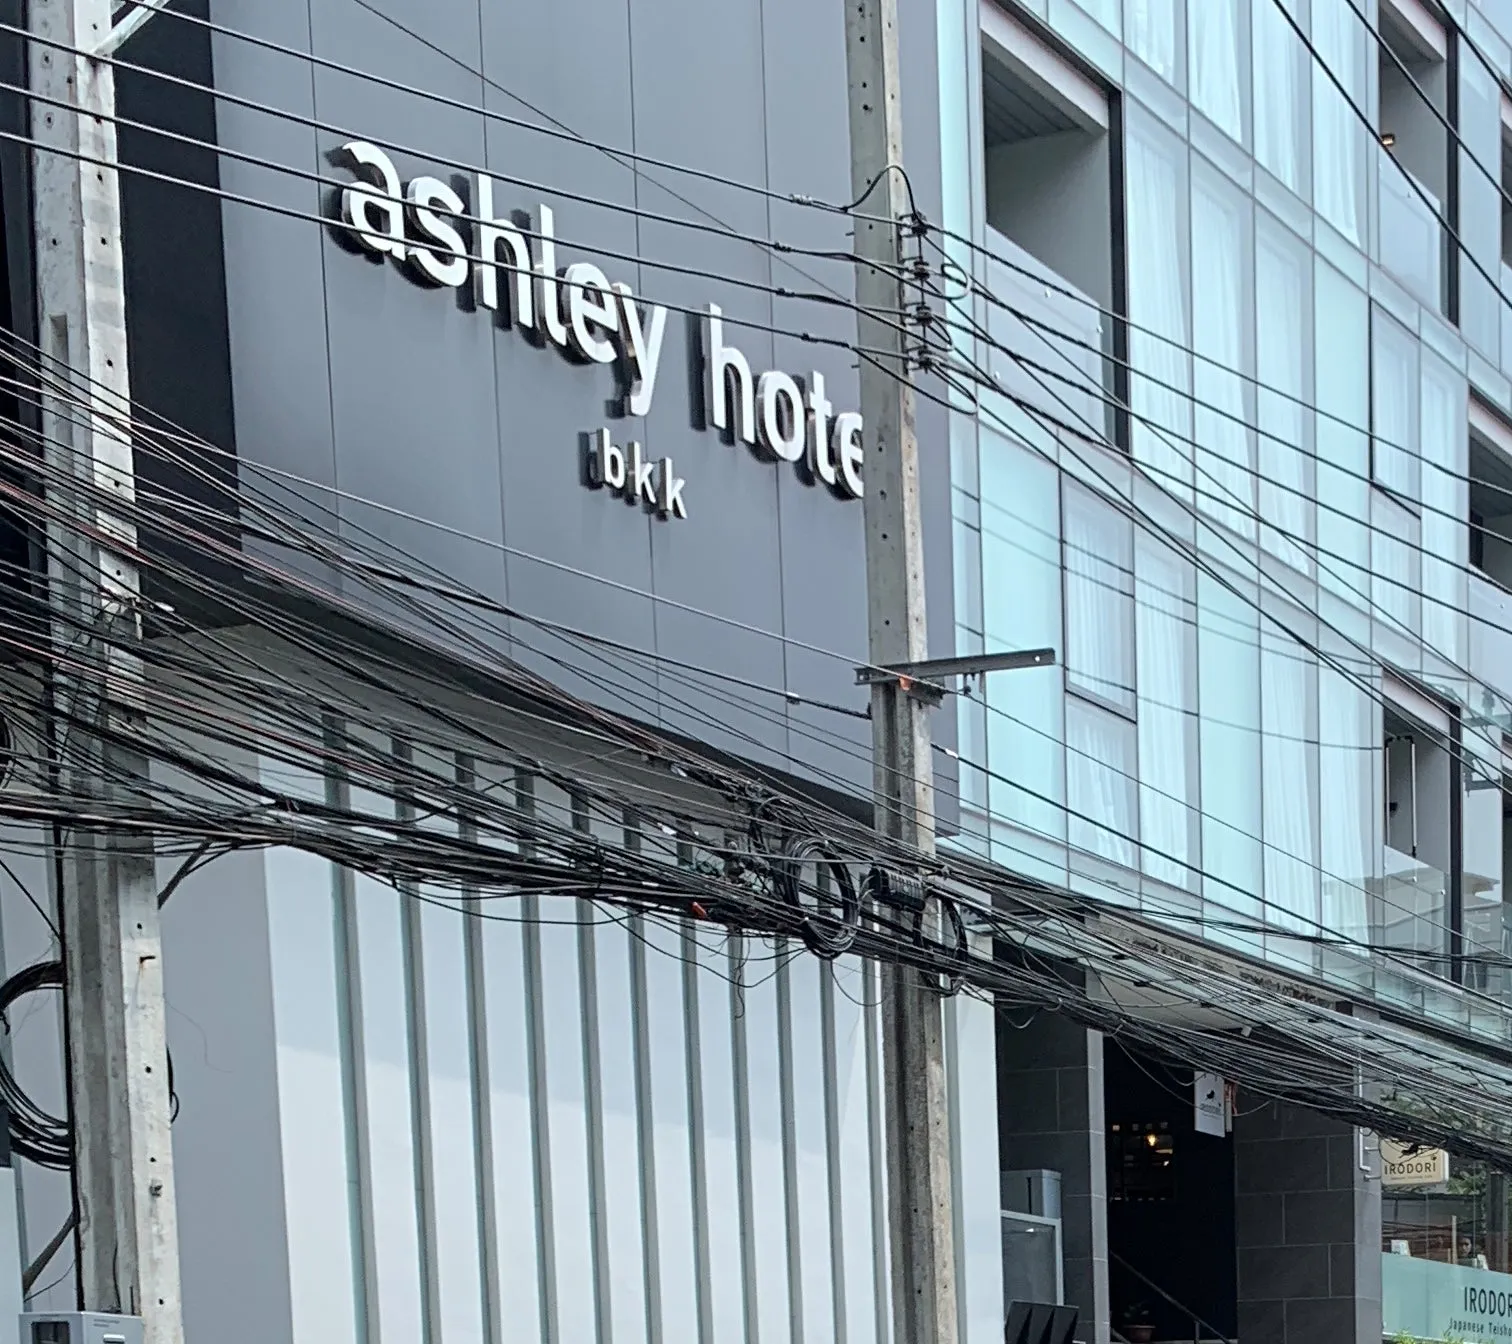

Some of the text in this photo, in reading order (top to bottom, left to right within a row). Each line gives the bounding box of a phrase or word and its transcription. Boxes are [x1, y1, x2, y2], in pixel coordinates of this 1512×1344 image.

[341, 140, 864, 498] ashley hote
[601, 429, 688, 519] bkk
[1383, 1161, 1437, 1176] IRODORI
[1448, 1317, 1484, 1334] Japanese
